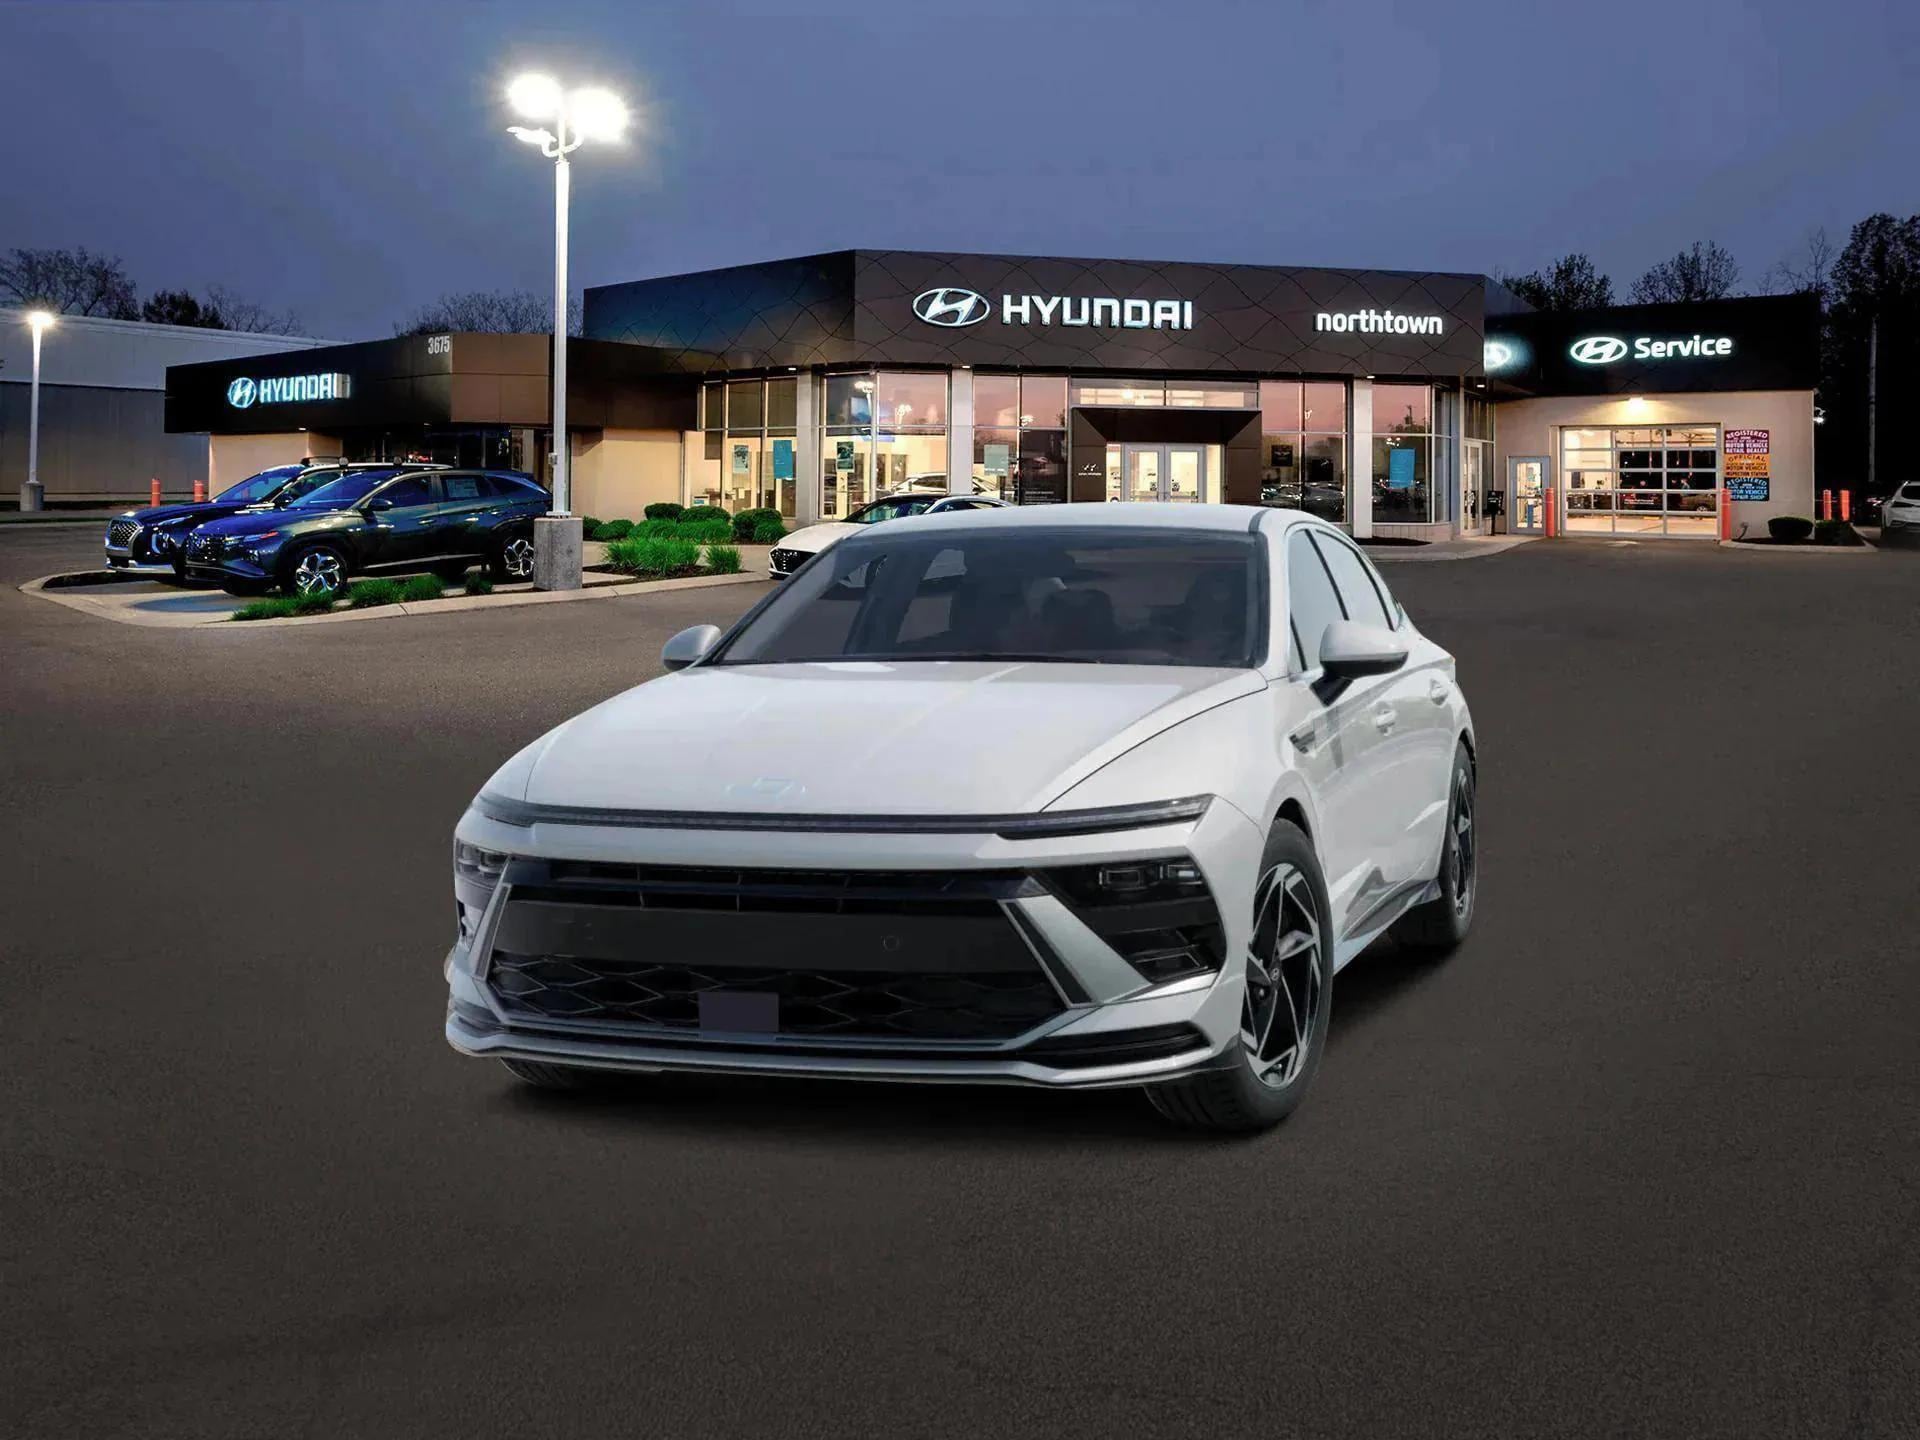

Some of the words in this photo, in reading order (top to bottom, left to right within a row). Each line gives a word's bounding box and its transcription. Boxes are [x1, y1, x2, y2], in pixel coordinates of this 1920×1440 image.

[1002, 294, 1193, 330] HYUNDAI
[1315, 309, 1443, 335] northtown
[427, 335, 450, 354] 3675
[1633, 334, 1733, 359] Service
[259, 372, 344, 403] HYUNDAI
[1726, 430, 1768, 439] REGISTERED
[1728, 454, 1766, 462] OFFICIAL
[1726, 477, 1767, 486] REGISTERED
